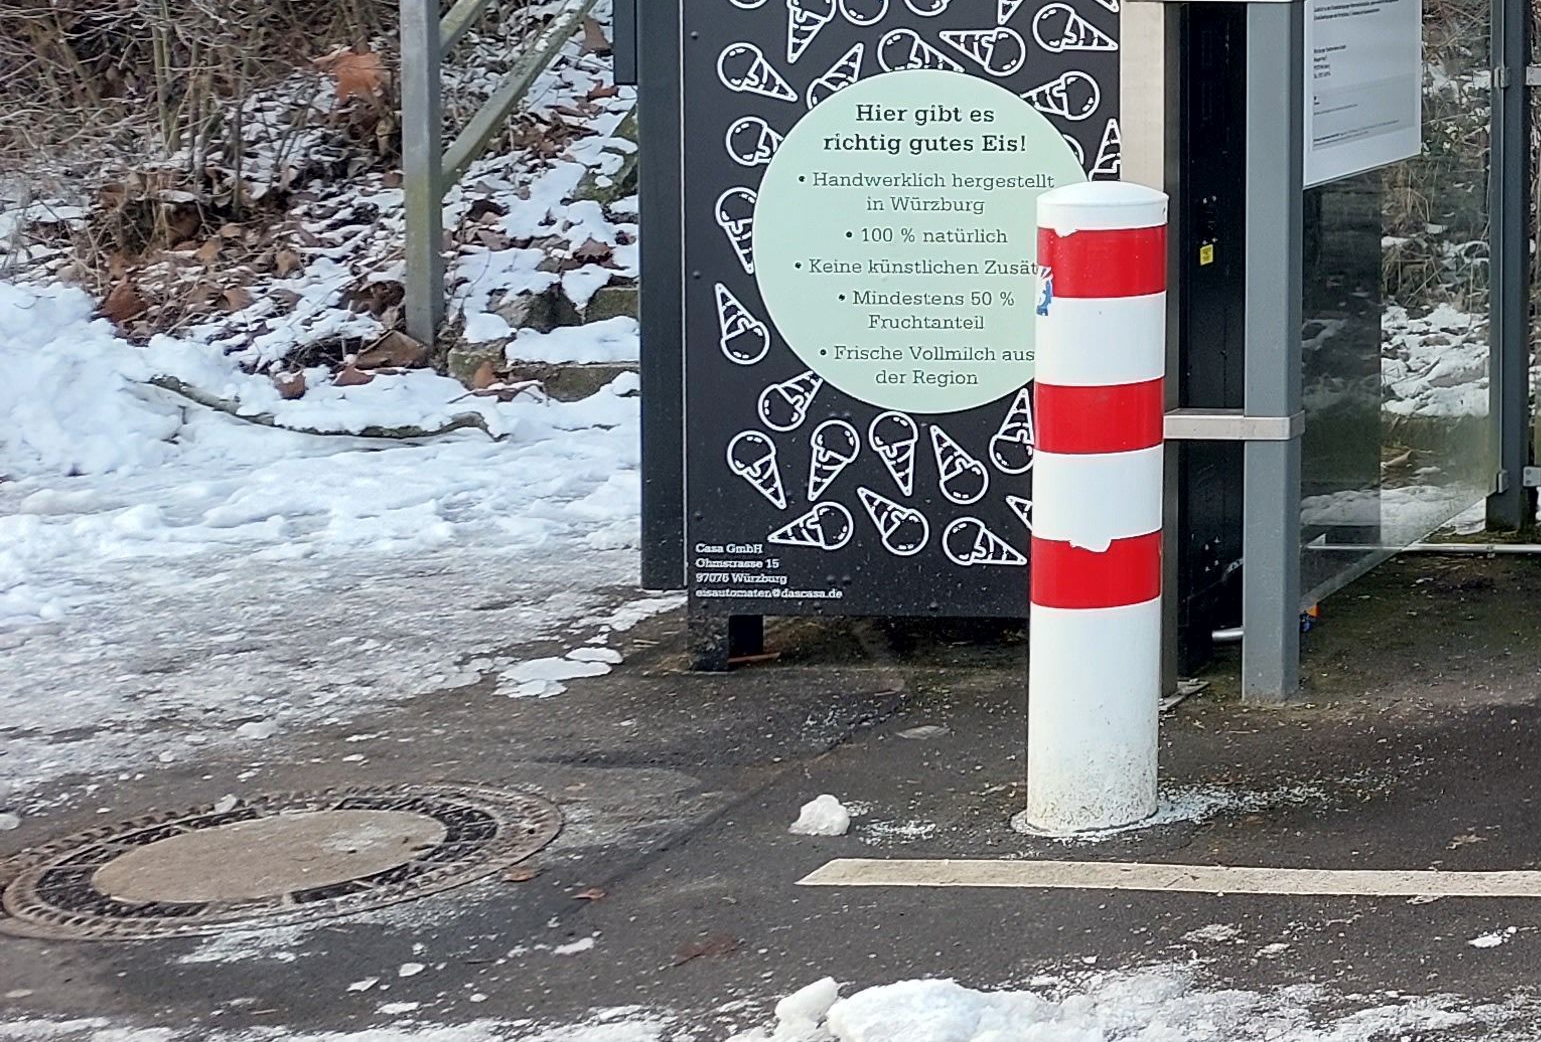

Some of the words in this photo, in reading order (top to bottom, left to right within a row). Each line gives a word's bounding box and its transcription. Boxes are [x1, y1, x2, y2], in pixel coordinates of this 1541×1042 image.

[855, 104, 908, 123] Hier
[914, 103, 961, 126] gibt
[969, 108, 995, 123] es
[823, 133, 902, 155] richtig
[908, 135, 975, 155] gutes
[981, 133, 1027, 153] Eis!
[812, 172, 946, 188] Handwerklich
[951, 172, 1054, 191] hergestellt
[866, 196, 885, 211] in
[890, 196, 985, 214] Würzburg
[861, 227, 893, 243] 100
[900, 227, 916, 243] %
[922, 228, 1009, 244] natürlich
[808, 259, 863, 274] Keine
[868, 259, 979, 275] künstlichen
[984, 260, 1038, 275] Zusät
[852, 291, 965, 306] Mindestens
[970, 291, 993, 306] 50
[999, 291, 1016, 307] %
[868, 314, 985, 330] Fruchtanteil
[834, 345, 904, 361] Frische
[909, 346, 996, 361] Vollmilch
[1001, 349, 1036, 362] aus
[875, 370, 907, 385] der
[912, 370, 979, 388] Region
[695, 543, 724, 554] Casa
[726, 543, 763, 554] GmbH
[695, 558, 763, 569] Ohmstrasse
[765, 558, 780, 569] 15
[731, 572, 788, 585] Würzburg
[695, 588, 843, 599] eisautomaten@dascasa.de
